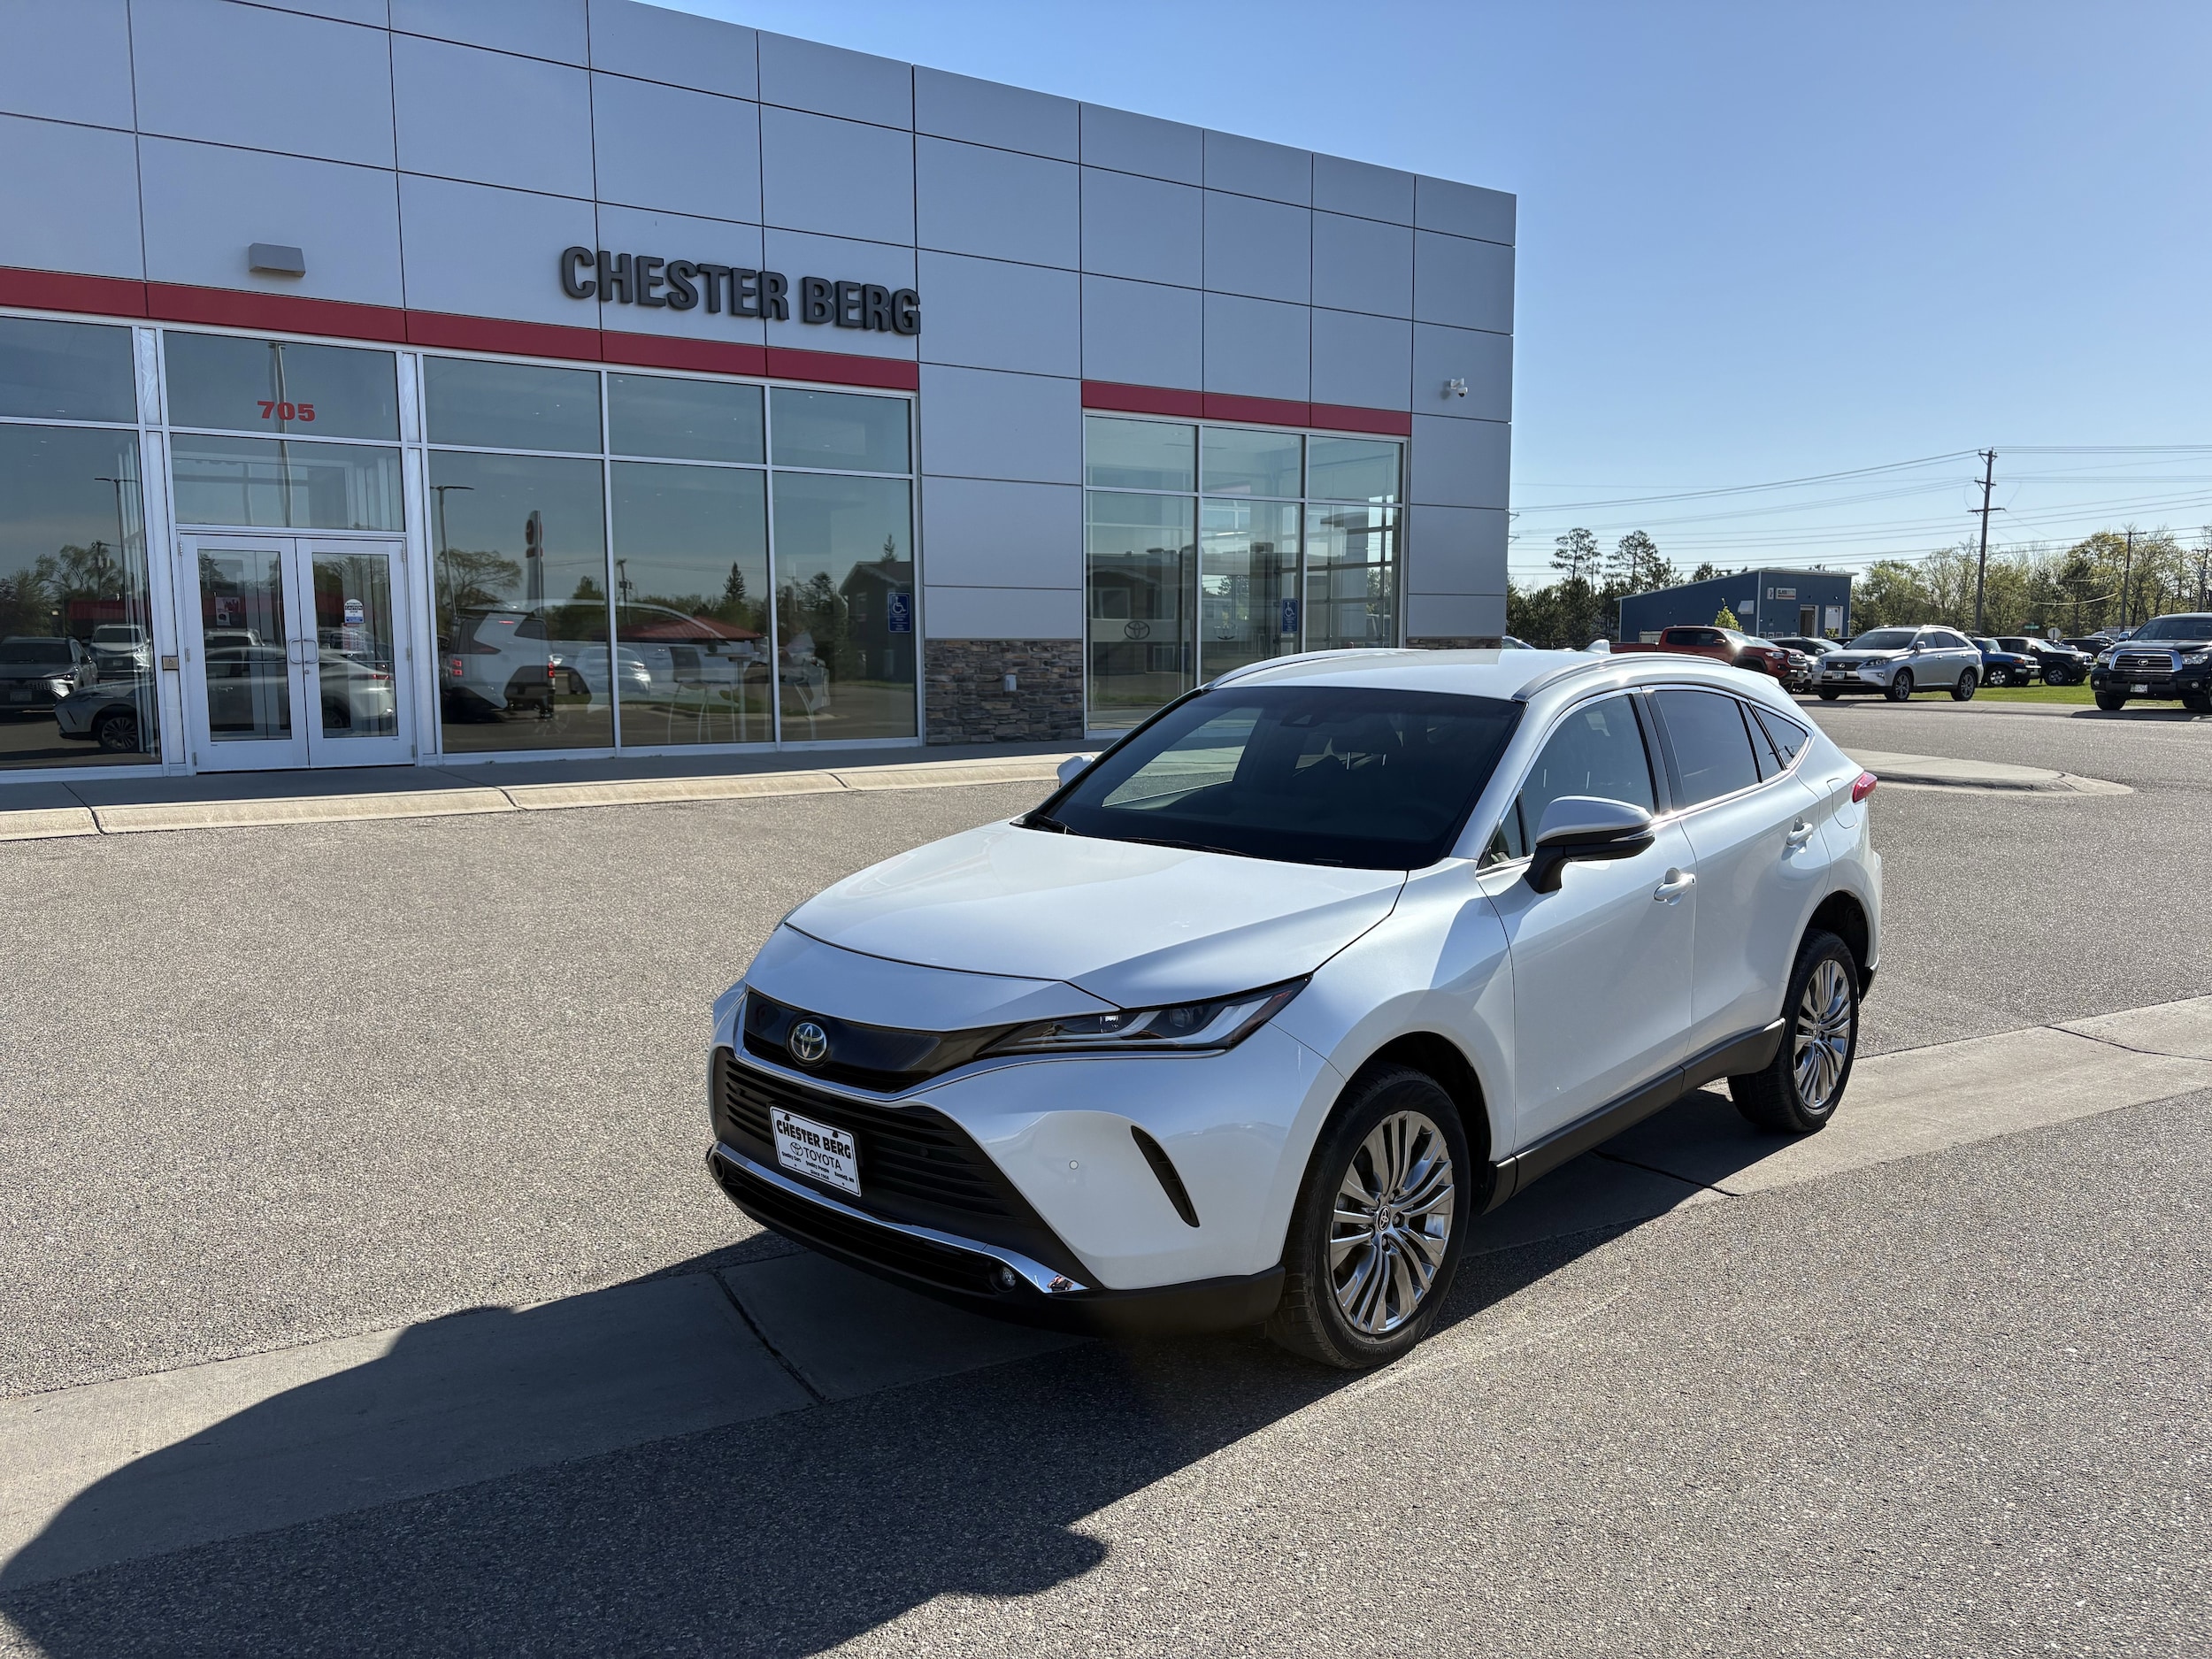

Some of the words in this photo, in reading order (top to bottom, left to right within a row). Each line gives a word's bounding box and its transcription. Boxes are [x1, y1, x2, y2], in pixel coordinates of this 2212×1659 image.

[561, 246, 789, 320] CHESTER
[802, 276, 921, 334] BERG
[257, 401, 316, 422] 705
[776, 1120, 821, 1148] CHESTER
[822, 1137, 851, 1159] BERG
[803, 1147, 842, 1171] TOYOTA
